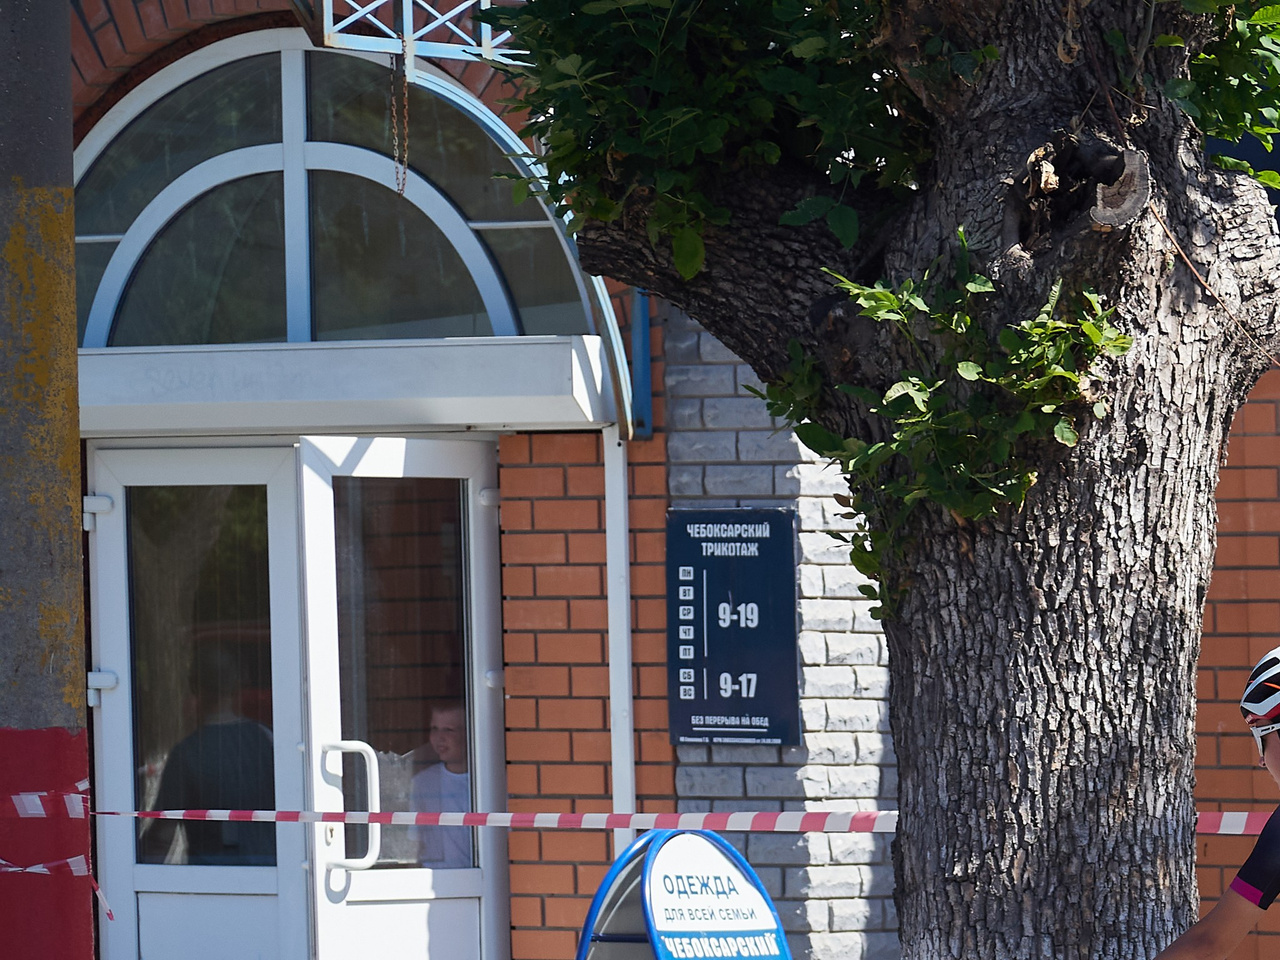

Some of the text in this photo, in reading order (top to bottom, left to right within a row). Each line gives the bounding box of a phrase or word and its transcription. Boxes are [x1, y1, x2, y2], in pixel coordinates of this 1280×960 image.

[686, 522, 770, 538] ЧЕБОКСАРСКИЙ
[701, 542, 759, 556] ТРИКОТАЖ
[681, 568, 692, 578] ПН
[682, 588, 691, 597] ВТ
[681, 607, 692, 617] СР
[718, 602, 759, 628] 9-19
[682, 627, 691, 637] ЧТ
[682, 647, 691, 657] ПТ
[682, 671, 692, 680] СБ
[719, 672, 757, 698] 9-17
[683, 688, 692, 697] ВС
[691, 715, 769, 727] БЕЗ ПЕРЕРЫВА НА ОБЕД
[663, 874, 739, 899] ОДЕЖДА
[664, 905, 757, 922] ДЛЯ ВСЕЙ СЕМЬИ
